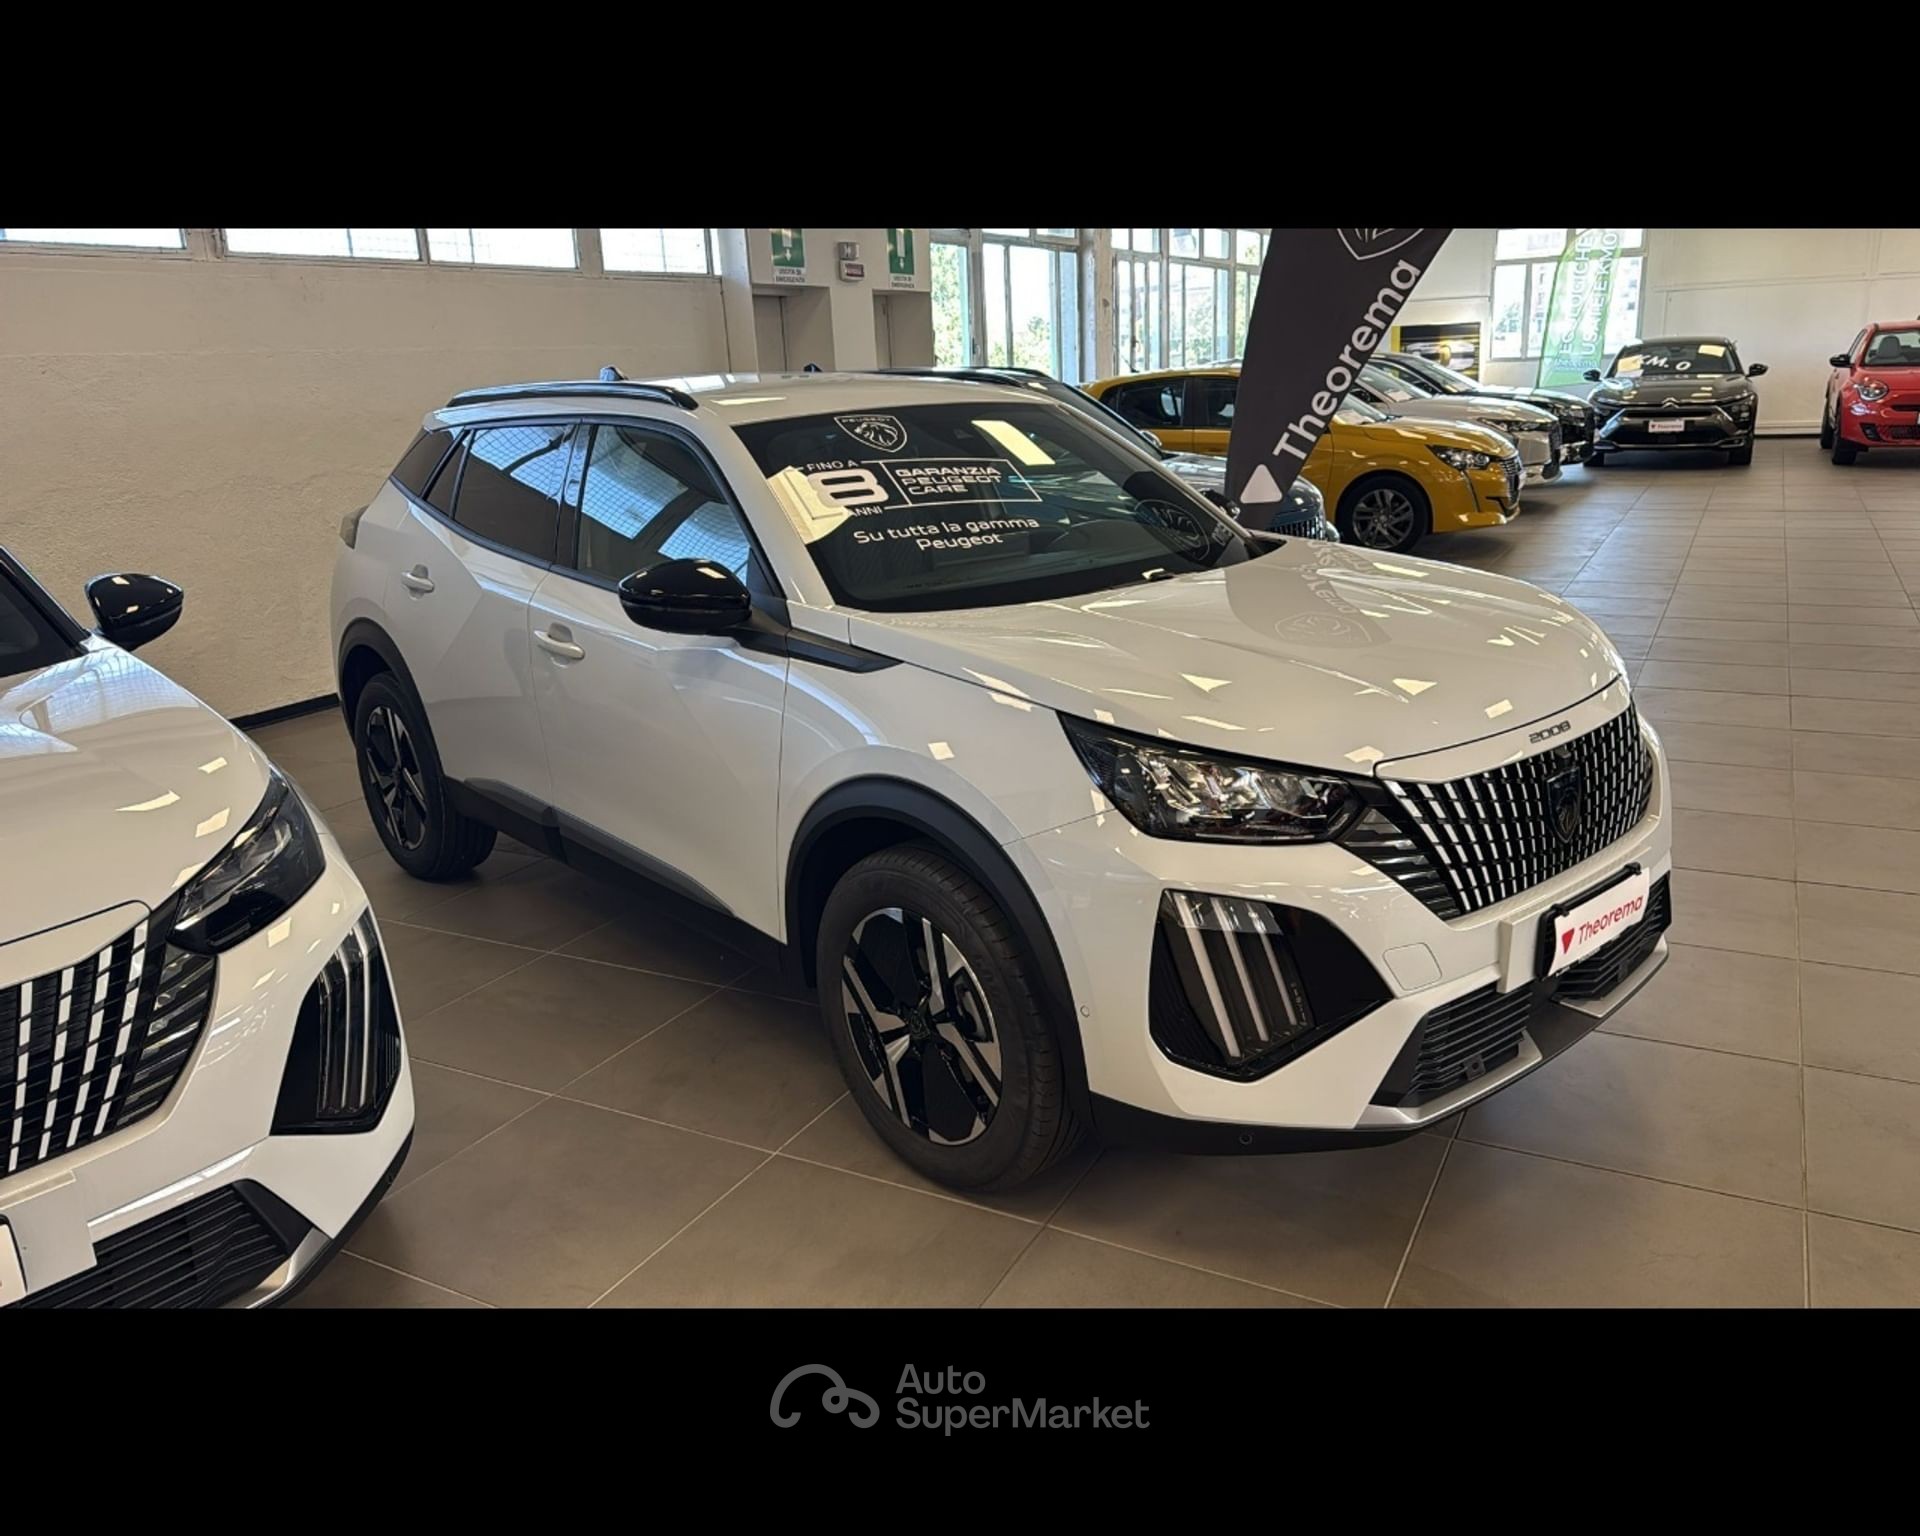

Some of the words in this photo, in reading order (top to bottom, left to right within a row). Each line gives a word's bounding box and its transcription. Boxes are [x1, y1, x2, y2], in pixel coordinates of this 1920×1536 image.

[1272, 259, 1422, 462] Theorema
[806, 460, 844, 472] FINO
[847, 459, 859, 468] A
[895, 466, 1002, 477] GARANZIA
[807, 468, 889, 509] 8
[901, 475, 1002, 486] PEUGEOT
[908, 484, 968, 495] CARE
[853, 530, 885, 544] Su
[887, 524, 940, 540] tutta
[941, 521, 962, 533] la
[965, 517, 1040, 533] gamma
[915, 532, 1004, 551] Peugeot
[1528, 720, 1572, 744] 2008
[1578, 895, 1643, 946] Theorema
